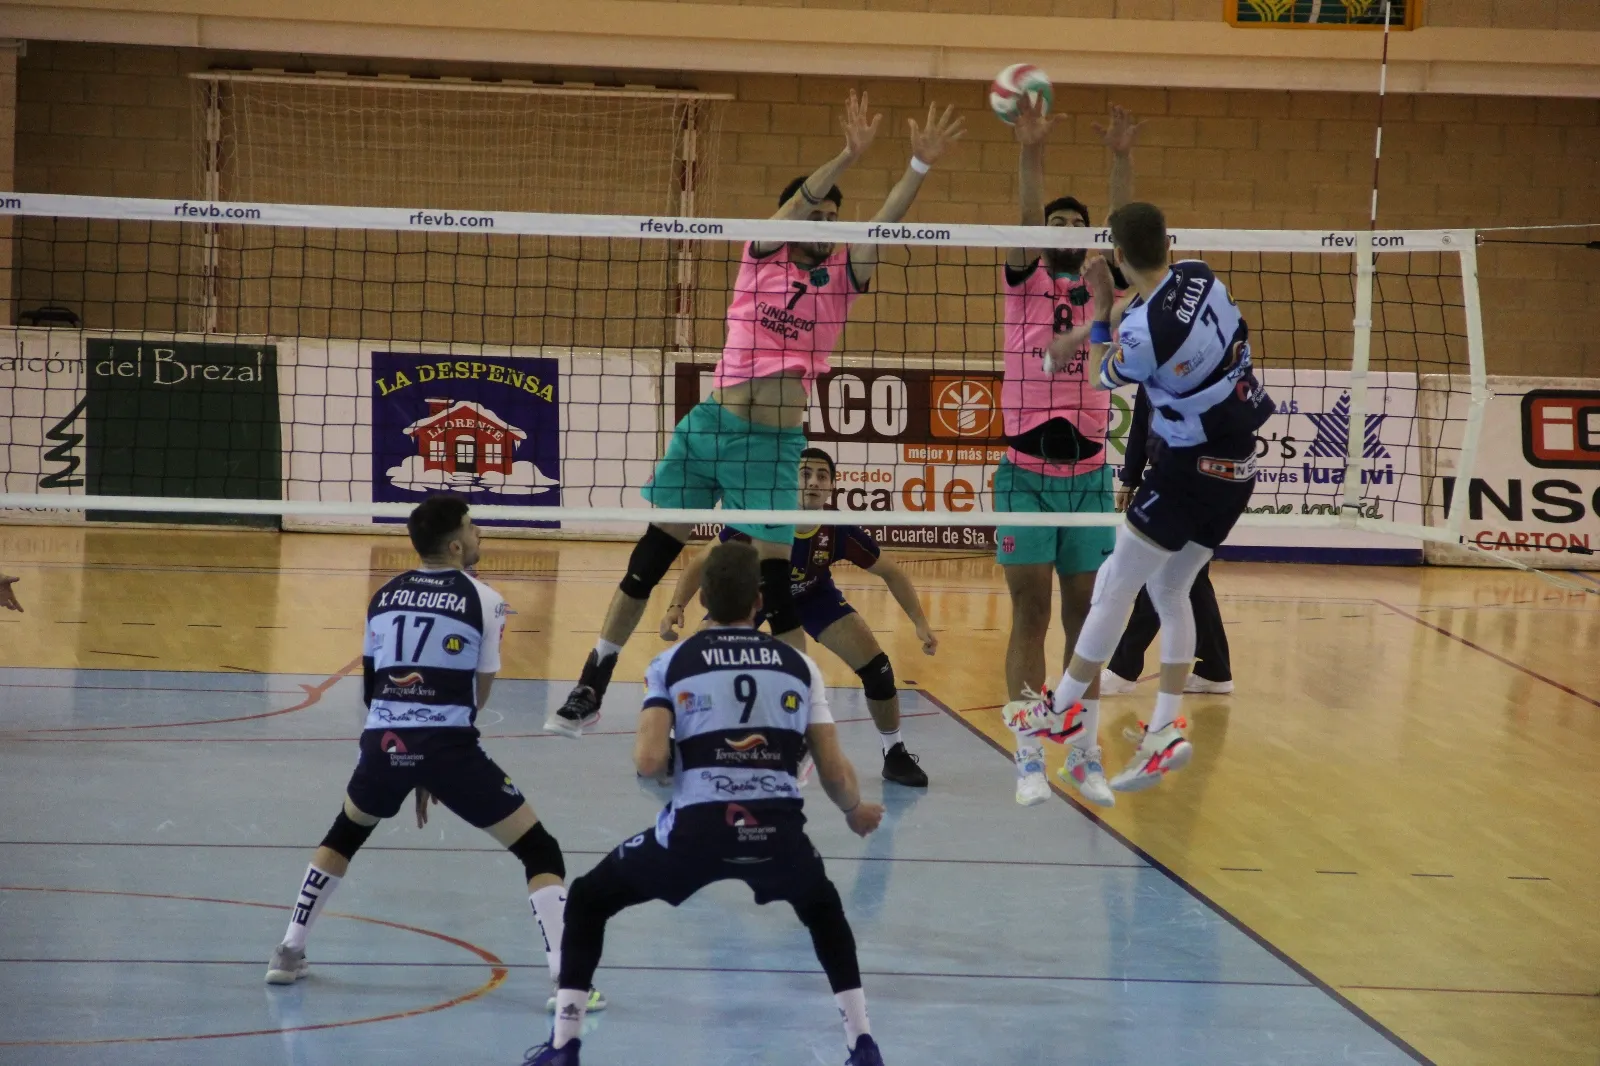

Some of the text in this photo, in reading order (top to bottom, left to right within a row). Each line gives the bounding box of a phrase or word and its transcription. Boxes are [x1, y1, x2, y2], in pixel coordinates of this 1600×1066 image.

[174, 202, 261, 219] rfevb.com
[409, 210, 494, 228] rfevb.com
[640, 219, 723, 235] rfevb.com
[867, 225, 950, 240] rfevb.com
[1321, 233, 1404, 247] rfevcom
[787, 281, 807, 310] 7
[1175, 278, 1208, 324] OLALLA
[760, 316, 799, 341] BARÇA
[1053, 303, 1073, 334] 8
[1200, 304, 1226, 350] 7
[96, 346, 142, 378] del
[153, 348, 264, 385] Brezal
[375, 361, 553, 403] LA DESPENSA
[803, 374, 908, 437] ACO
[427, 418, 503, 442] LLORENTE
[908, 448, 943, 461] mejor
[943, 450, 953, 461] y
[957, 447, 983, 461] más
[836, 468, 892, 483] ercado
[1303, 463, 1394, 485] luavi
[1443, 476, 1600, 523] INS
[875, 526, 887, 542] al
[891, 527, 938, 543] cuartel
[942, 527, 959, 544] de
[963, 527, 989, 545] Sta.
[378, 589, 467, 613] X. FOLGUERA
[392, 614, 436, 663] 17
[701, 647, 783, 666] VILLALBA
[733, 673, 758, 724] 9
